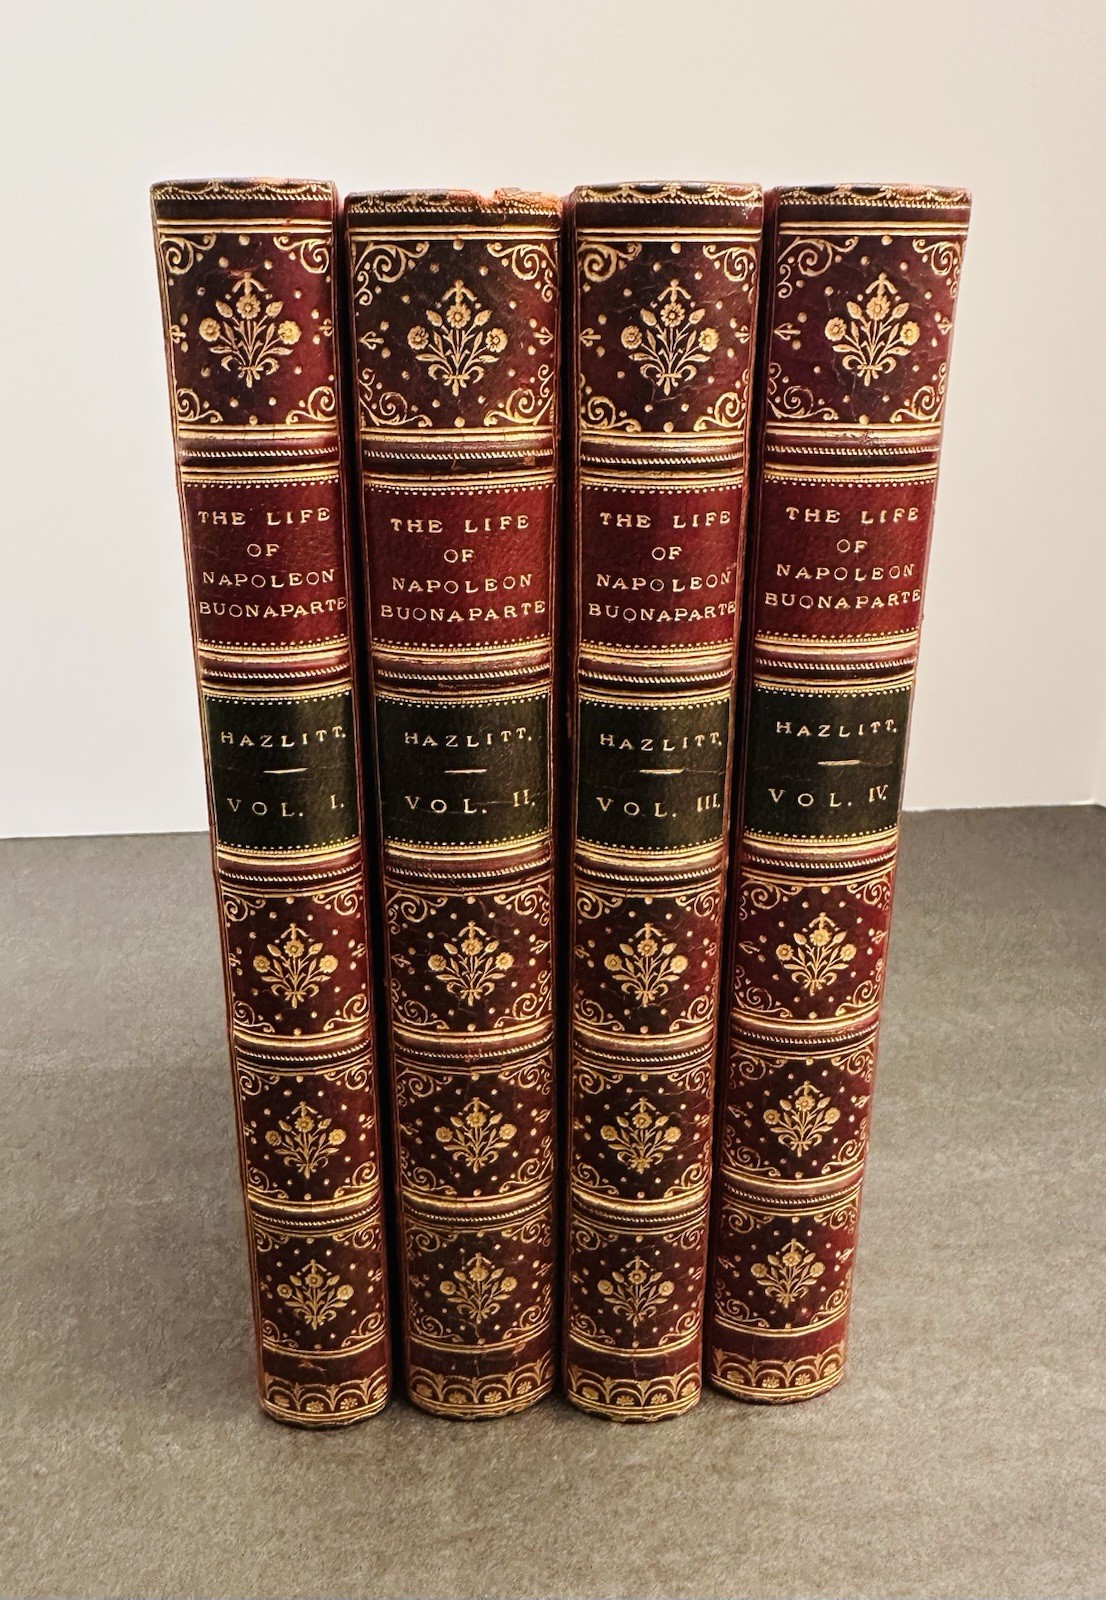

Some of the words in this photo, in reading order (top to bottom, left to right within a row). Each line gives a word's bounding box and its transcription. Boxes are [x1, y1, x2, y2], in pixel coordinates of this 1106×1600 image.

[198, 511, 246, 525] THE
[267, 507, 330, 525] LIFE
[391, 518, 443, 533] THE
[465, 515, 529, 533] LIFE
[600, 513, 651, 528] THE
[673, 511, 730, 528] LIFE
[786, 507, 840, 523] THE
[861, 507, 918, 524] LIFE
[247, 544, 279, 557] OF
[651, 547, 682, 560] OF
[837, 539, 867, 553] OF
[444, 549, 474, 563] OF
[203, 569, 335, 588] NAPOLEON
[596, 571, 731, 592] NAPOLEON
[776, 564, 914, 581] NAPOLEON
[392, 574, 532, 594] NAPOLEON
[200, 597, 347, 618] BUONAPARTE
[765, 589, 921, 609] BUONAPARTE
[381, 601, 545, 622] BUONAPARTE
[588, 601, 736, 622] BUONAPARTE
[221, 726, 346, 747] HAZLITT.
[405, 727, 532, 747] HAZLITT.
[776, 719, 897, 737] HAZLITT.
[600, 732, 722, 751] HAZLITT.
[227, 798, 303, 817] VOL.
[331, 794, 344, 809] I.
[405, 796, 487, 814] VOL.
[513, 789, 535, 807] II.
[596, 797, 677, 817] VOL.
[697, 793, 720, 812] III.
[768, 789, 852, 807] VOL.
[869, 785, 888, 802] IV.
